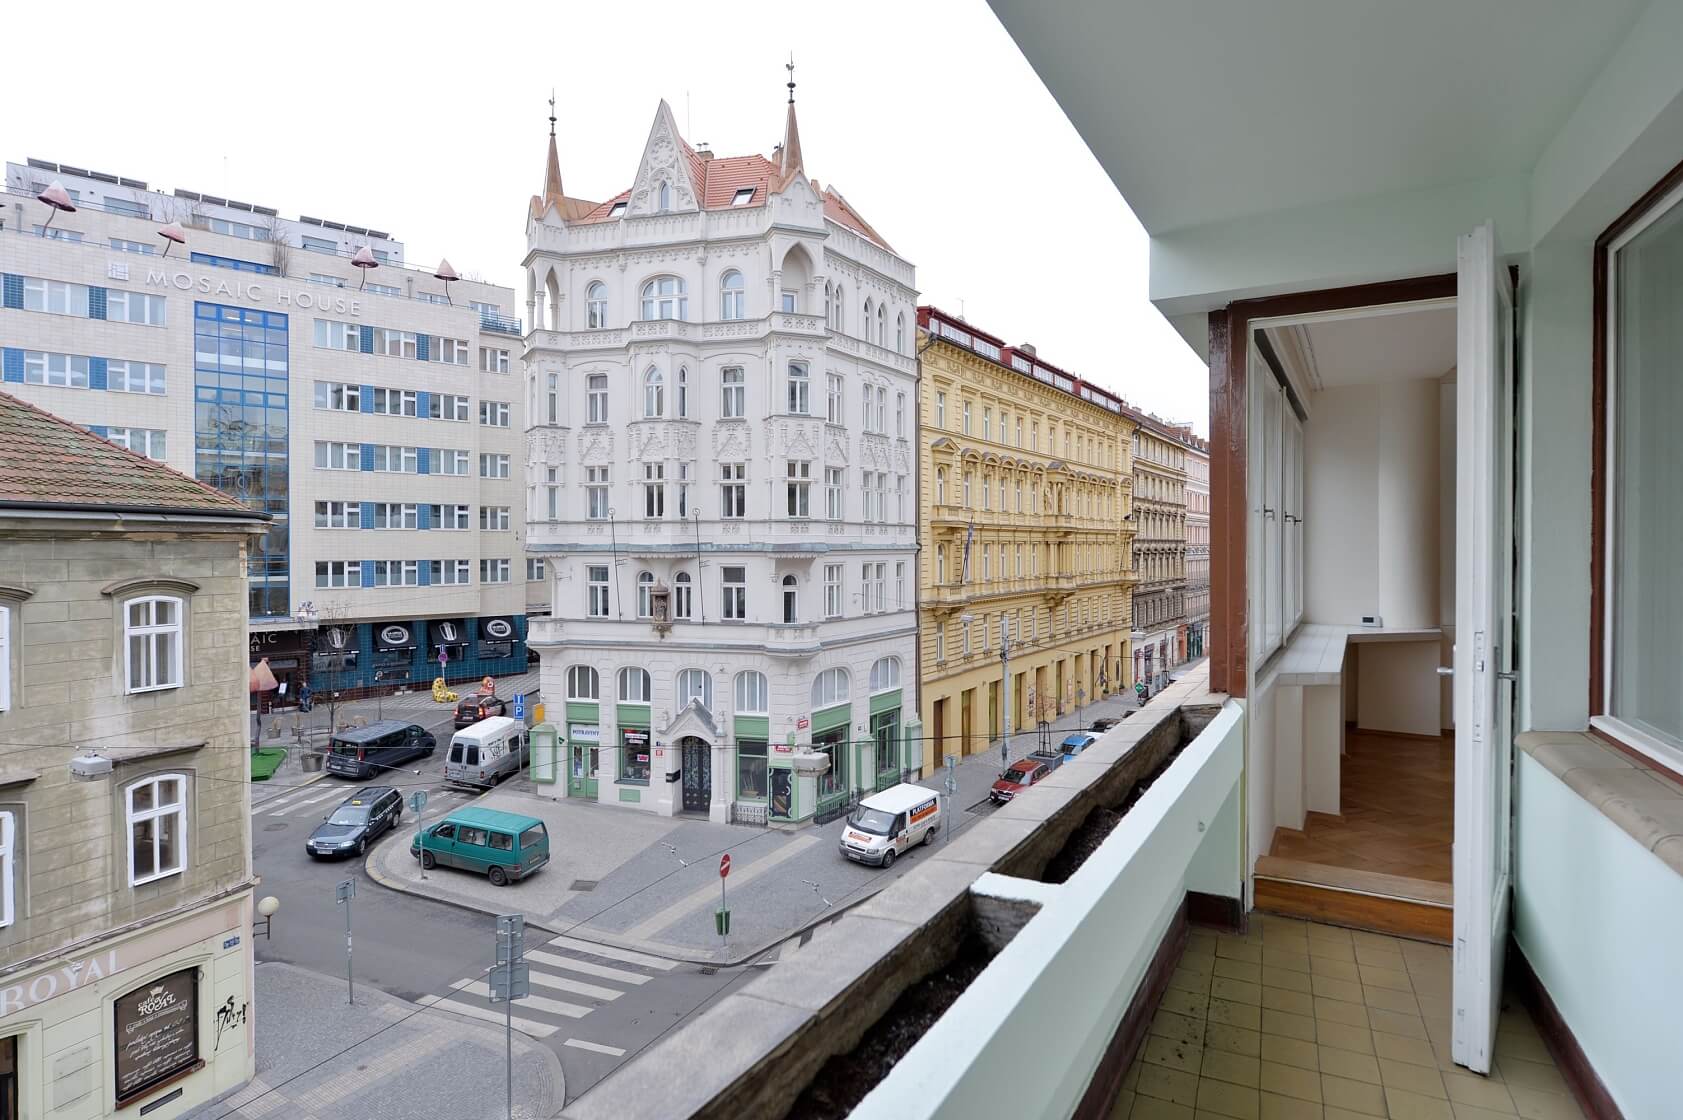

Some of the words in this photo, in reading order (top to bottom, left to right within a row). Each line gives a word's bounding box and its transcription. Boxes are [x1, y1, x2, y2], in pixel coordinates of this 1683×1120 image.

[146, 271, 262, 301] MOSAIC
[277, 288, 361, 316] HOUSE
[0, 949, 127, 1017] ROYAL
[138, 991, 177, 1016] ROYAL
